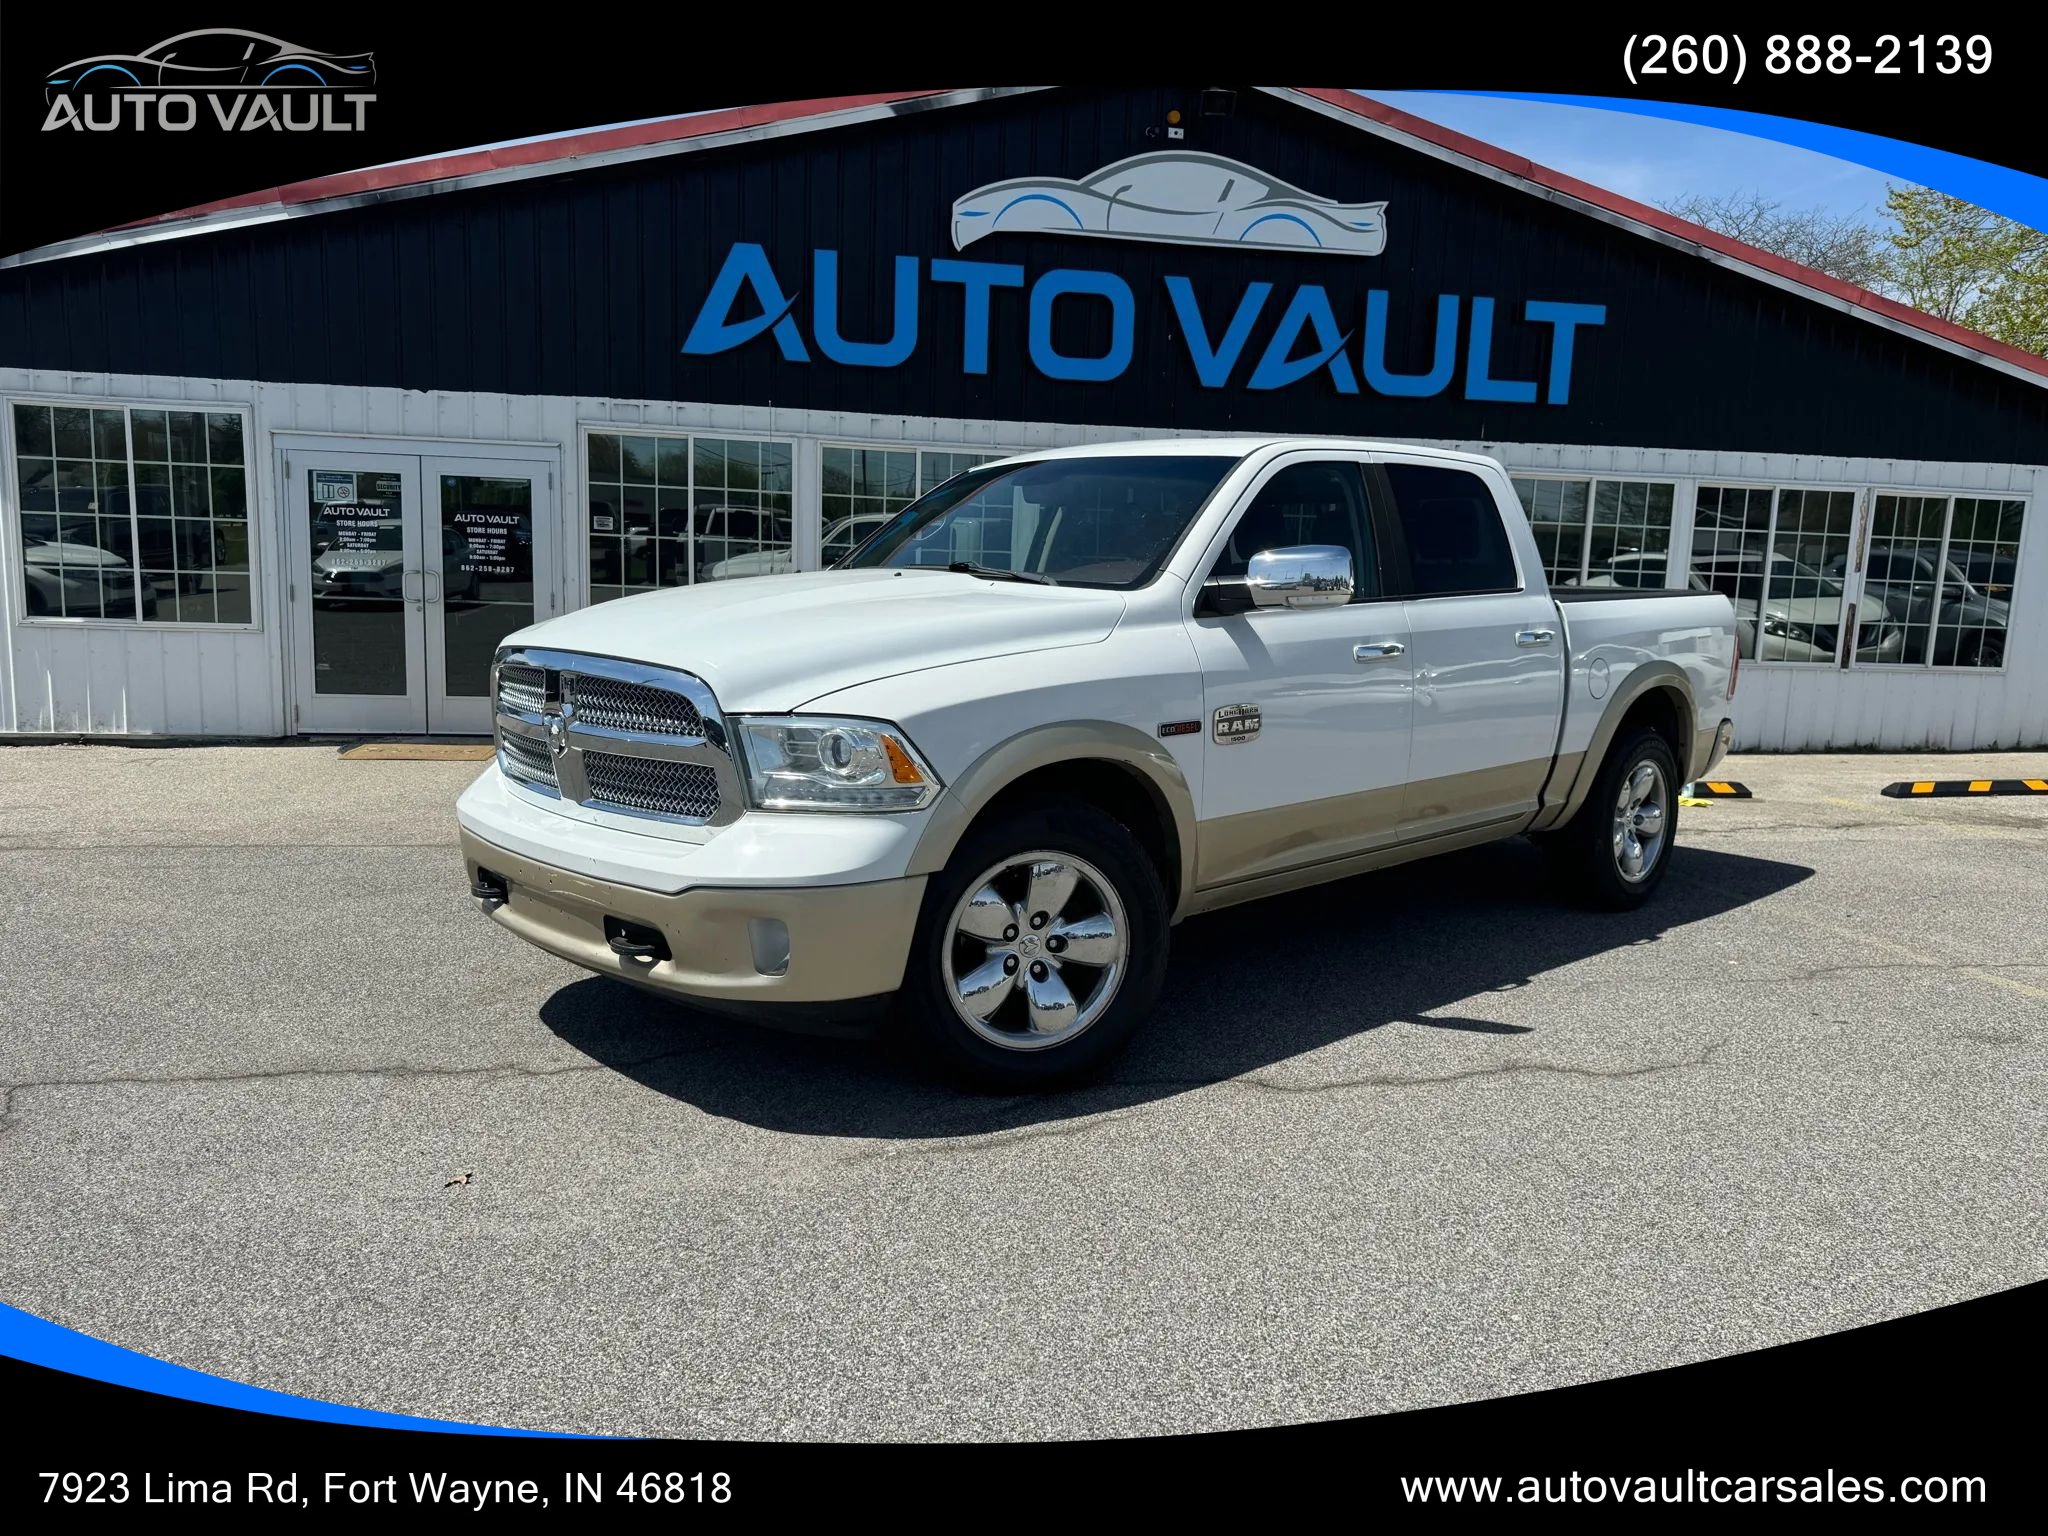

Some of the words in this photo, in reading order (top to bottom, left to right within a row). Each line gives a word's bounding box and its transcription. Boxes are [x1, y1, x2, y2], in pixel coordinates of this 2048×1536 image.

[681, 242, 1134, 383] AUTO
[1165, 274, 1607, 406] VAULT
[323, 507, 355, 516] AUTO
[356, 508, 391, 517] VAULT
[454, 514, 486, 523] AUTO
[487, 516, 520, 524] VAULT
[1217, 718, 1260, 734] RAM
